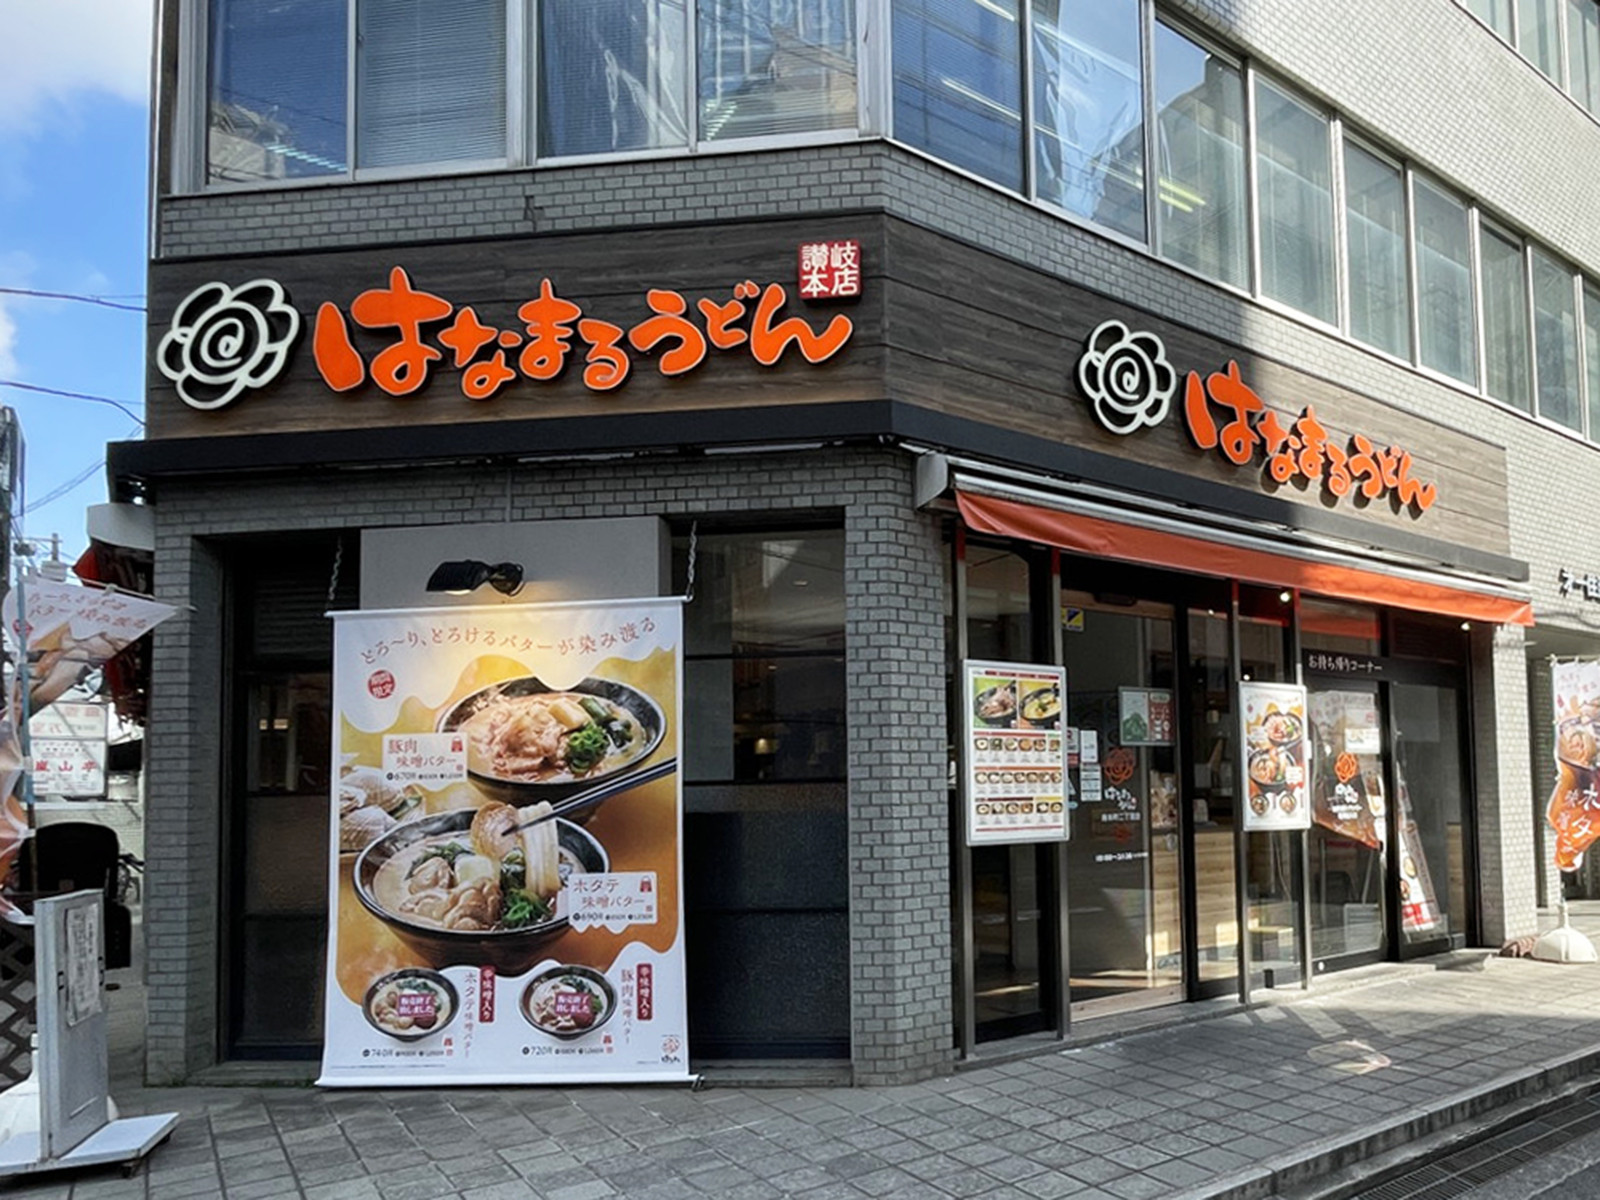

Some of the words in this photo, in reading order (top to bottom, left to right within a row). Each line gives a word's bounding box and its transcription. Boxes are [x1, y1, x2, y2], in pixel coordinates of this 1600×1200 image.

[313, 265, 853, 399] はなまるうどん
[1184, 359, 1436, 511] はなまるうどん
[1308, 654, 1382, 673] お持ち帰りコーナー
[387, 738, 417, 754] 豚肉
[396, 754, 456, 769] 味噌バター
[573, 879, 619, 893] ホタテ
[582, 894, 645, 910] 味噌バター
